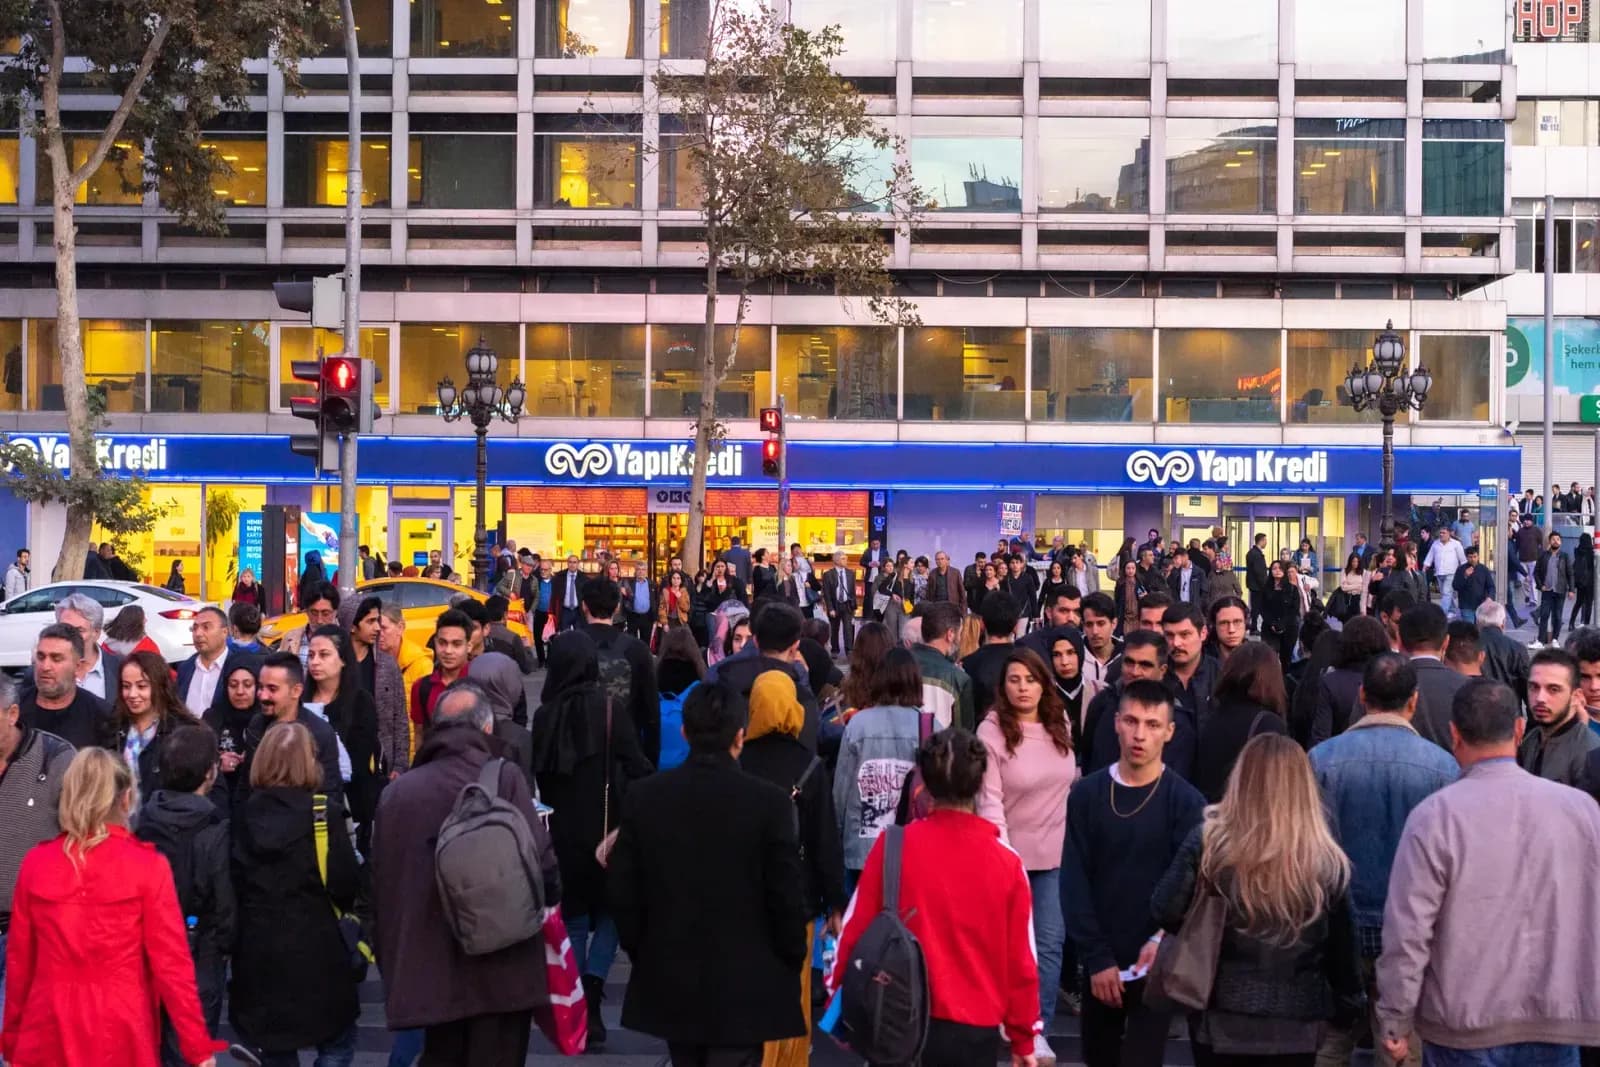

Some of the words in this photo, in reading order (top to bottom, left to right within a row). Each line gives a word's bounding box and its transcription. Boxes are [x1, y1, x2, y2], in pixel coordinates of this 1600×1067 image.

[1570, 359, 1595, 369] hem
[766, 412, 776, 427] 4
[38, 437, 70, 469] Ya
[1197, 449, 1252, 487] Yapı
[1256, 450, 1328, 482] Kredi
